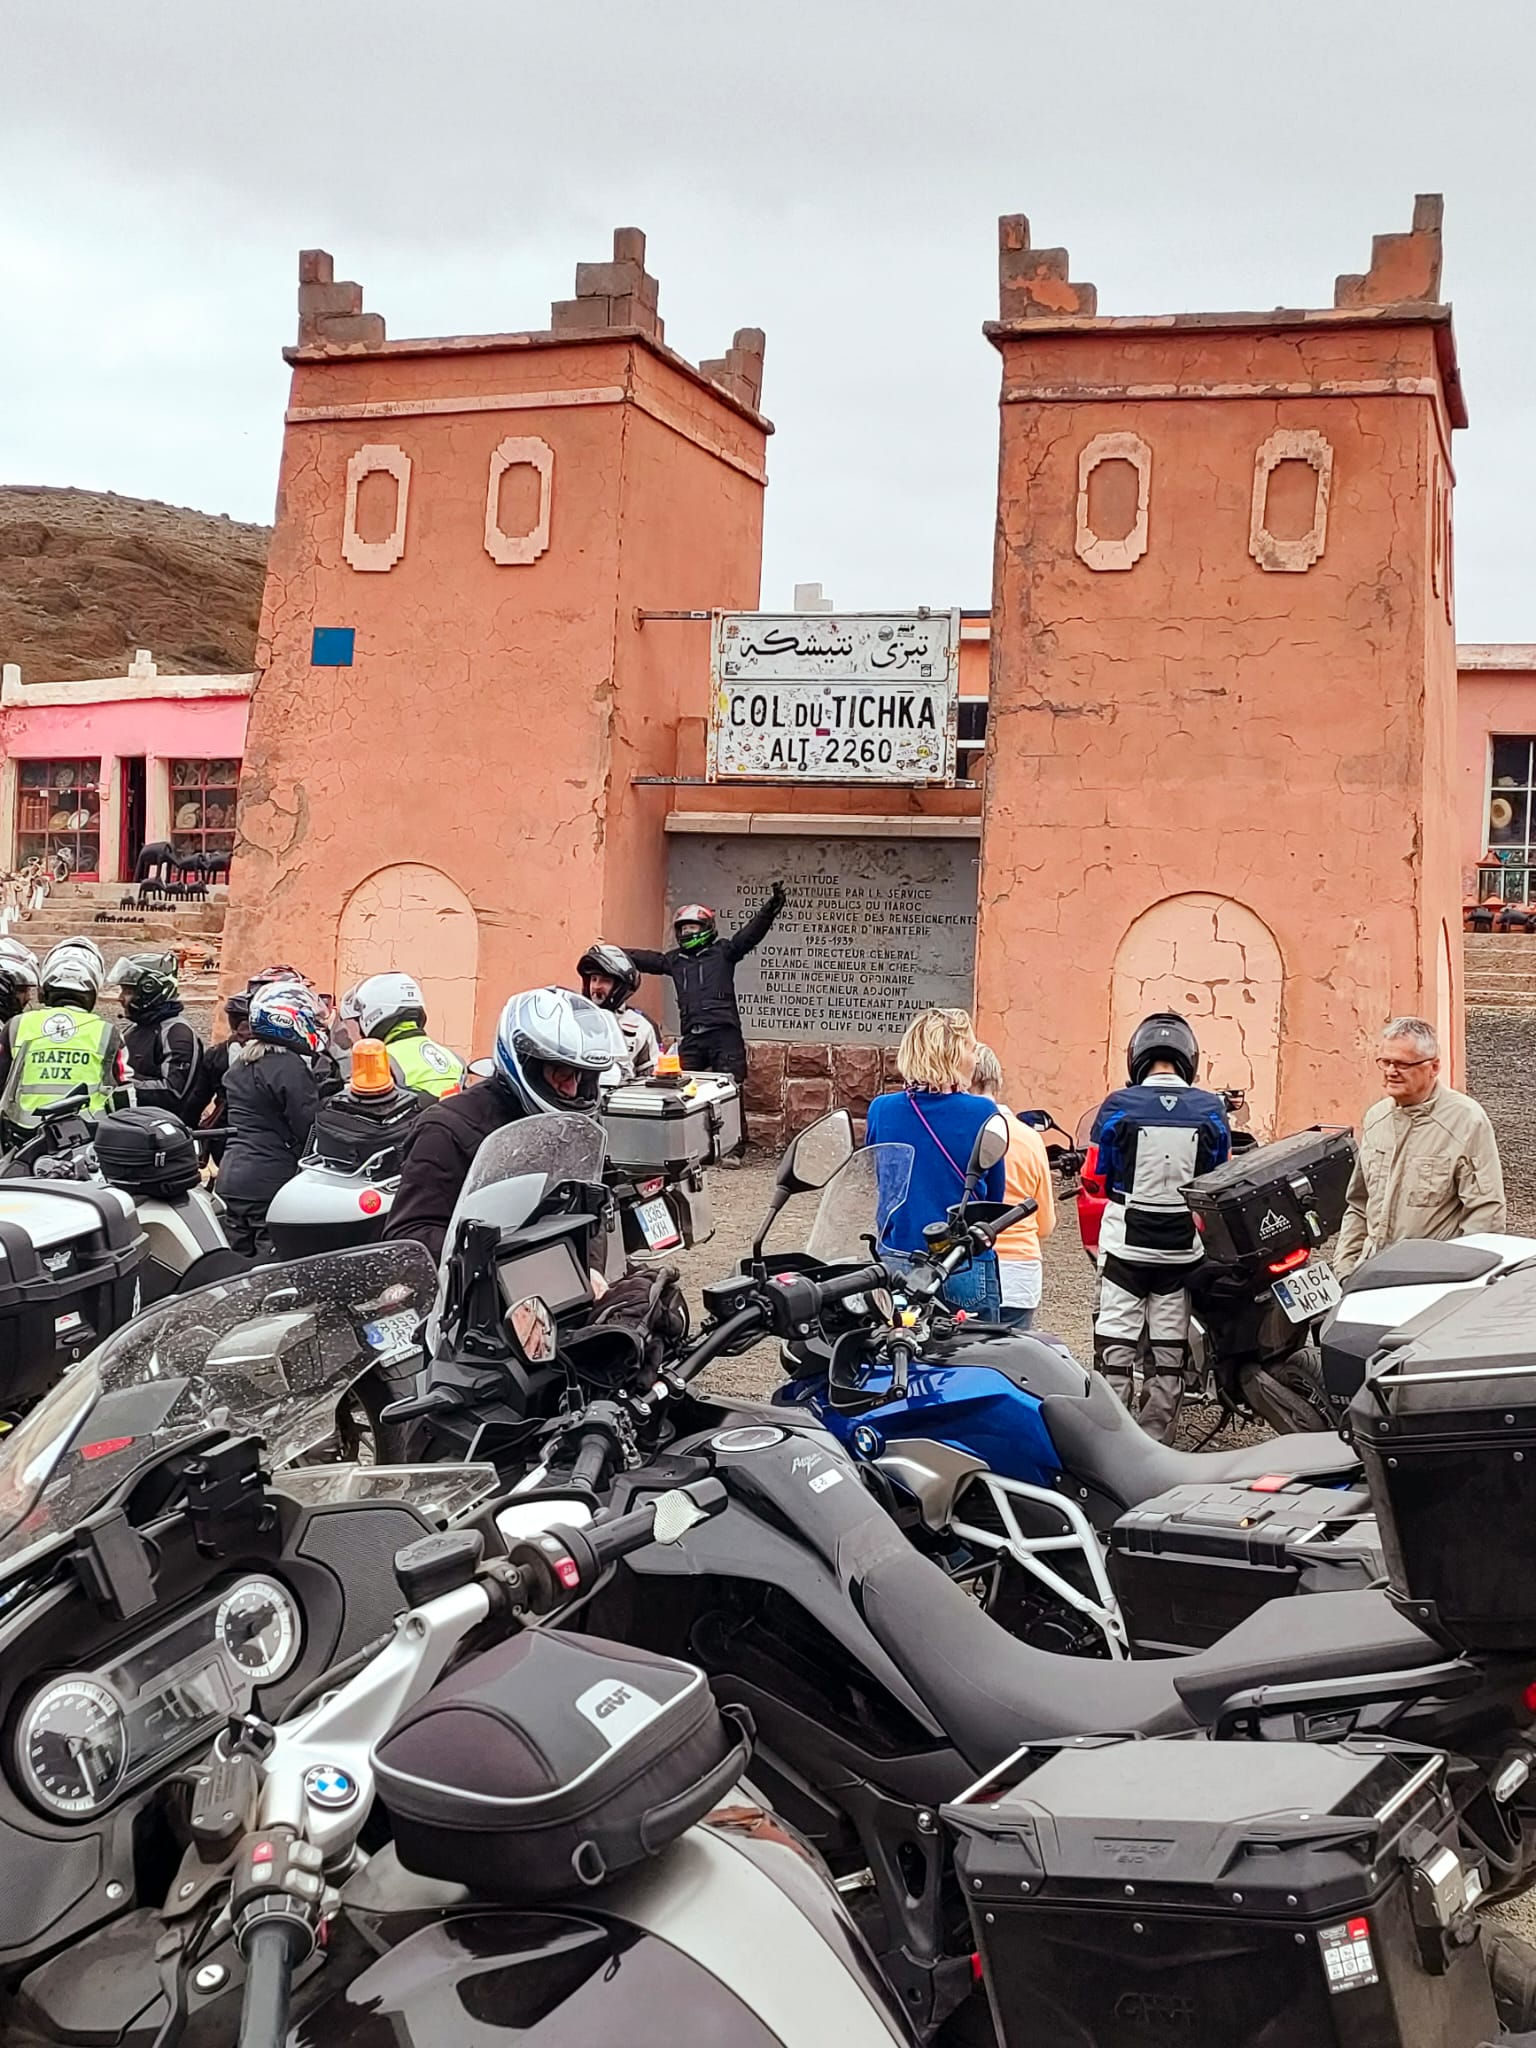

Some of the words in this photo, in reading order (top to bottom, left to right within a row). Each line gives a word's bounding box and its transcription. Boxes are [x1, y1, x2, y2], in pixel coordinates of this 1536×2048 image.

[731, 695, 785, 727] COL
[795, 703, 822, 727] DU
[832, 695, 936, 729] TICHKA
[825, 738, 892, 763] 2260
[737, 885, 770, 895] ROUTE
[783, 887, 840, 897] ONSTRUITE
[846, 888, 864, 897] PAR
[888, 890, 932, 899] SERVICE
[745, 898, 765, 907] DES
[817, 901, 861, 910] PUBLICS
[866, 902, 880, 910] DU
[720, 910, 736, 918] LE
[798, 912, 812, 920] DU
[816, 913, 859, 921] SERVICE
[865, 913, 884, 921] DES
[890, 914, 977, 925] RENSEIGNEMENTS
[779, 924, 799, 932] RGT
[803, 924, 857, 933] ETRANGER
[762, 946, 803, 956] JOYANT
[807, 949, 865, 958] DIRECTEUR
[761, 959, 809, 969] DELANDE
[814, 961, 866, 971] INGENIEUR
[871, 962, 884, 972] EN
[889, 963, 917, 973] CHEF
[760, 971, 796, 980] MARTIN
[801, 972, 854, 983] INGENIEUR
[766, 983, 801, 993] BULLE
[806, 984, 858, 995] INGENIEUR
[863, 987, 908, 997] ADJOINT
[738, 994, 775, 1004] PITAINE
[828, 997, 894, 1009] LIEUTENANT
[739, 1006, 752, 1015] DU
[757, 1007, 800, 1017] SERVICE
[805, 1009, 824, 1018] DES
[751, 1018, 815, 1029] LIEUTENANT
[858, 1022, 872, 1032] DU
[31, 1051, 90, 1065] TRAFICO
[40, 1067, 72, 1080] AUX
[1288, 1265, 1330, 1295] 3164
[1300, 1287, 1332, 1313] MPM
[595, 1686, 632, 1719] GIVI
